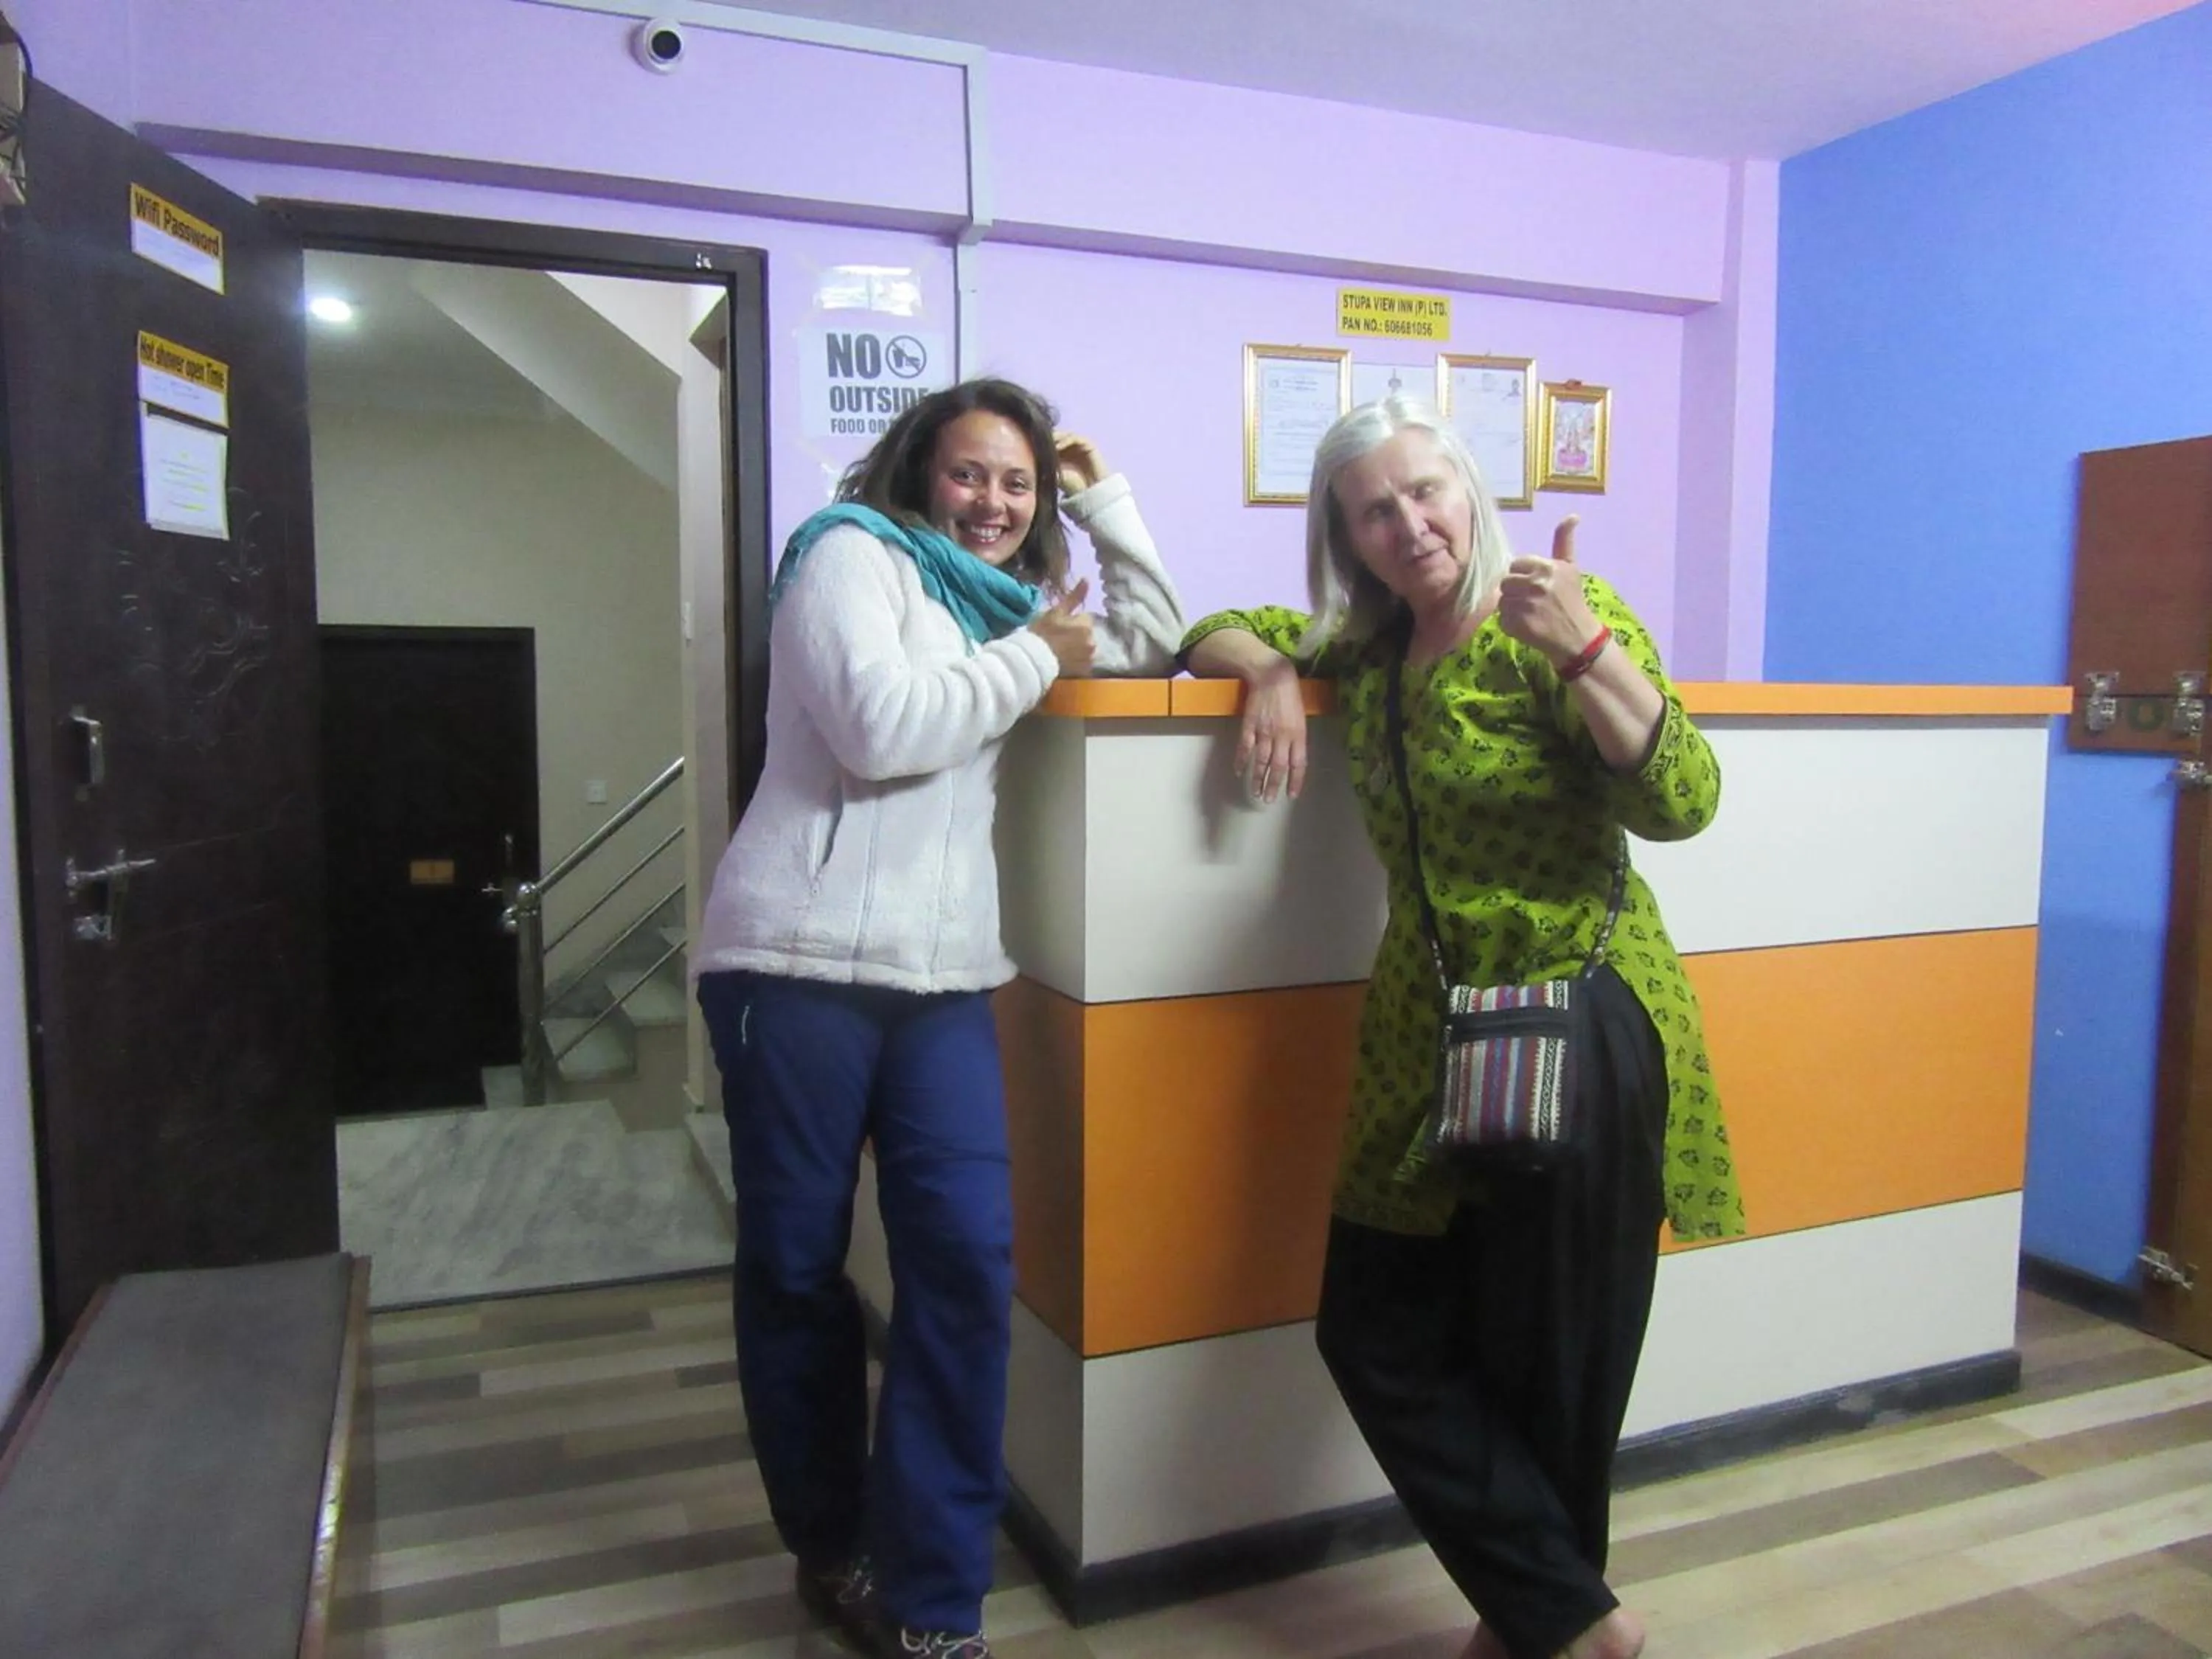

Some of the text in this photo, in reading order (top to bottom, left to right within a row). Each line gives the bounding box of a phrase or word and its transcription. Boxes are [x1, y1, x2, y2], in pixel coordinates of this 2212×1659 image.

[135, 190, 160, 231] Wifi
[164, 208, 219, 257] Password
[1342, 294, 1371, 309] STUPA
[1374, 296, 1395, 313] VIEW
[1398, 299, 1413, 314] INN
[1342, 316, 1361, 331] PAN
[826, 333, 882, 379] NO
[830, 418, 865, 434] FOOD
